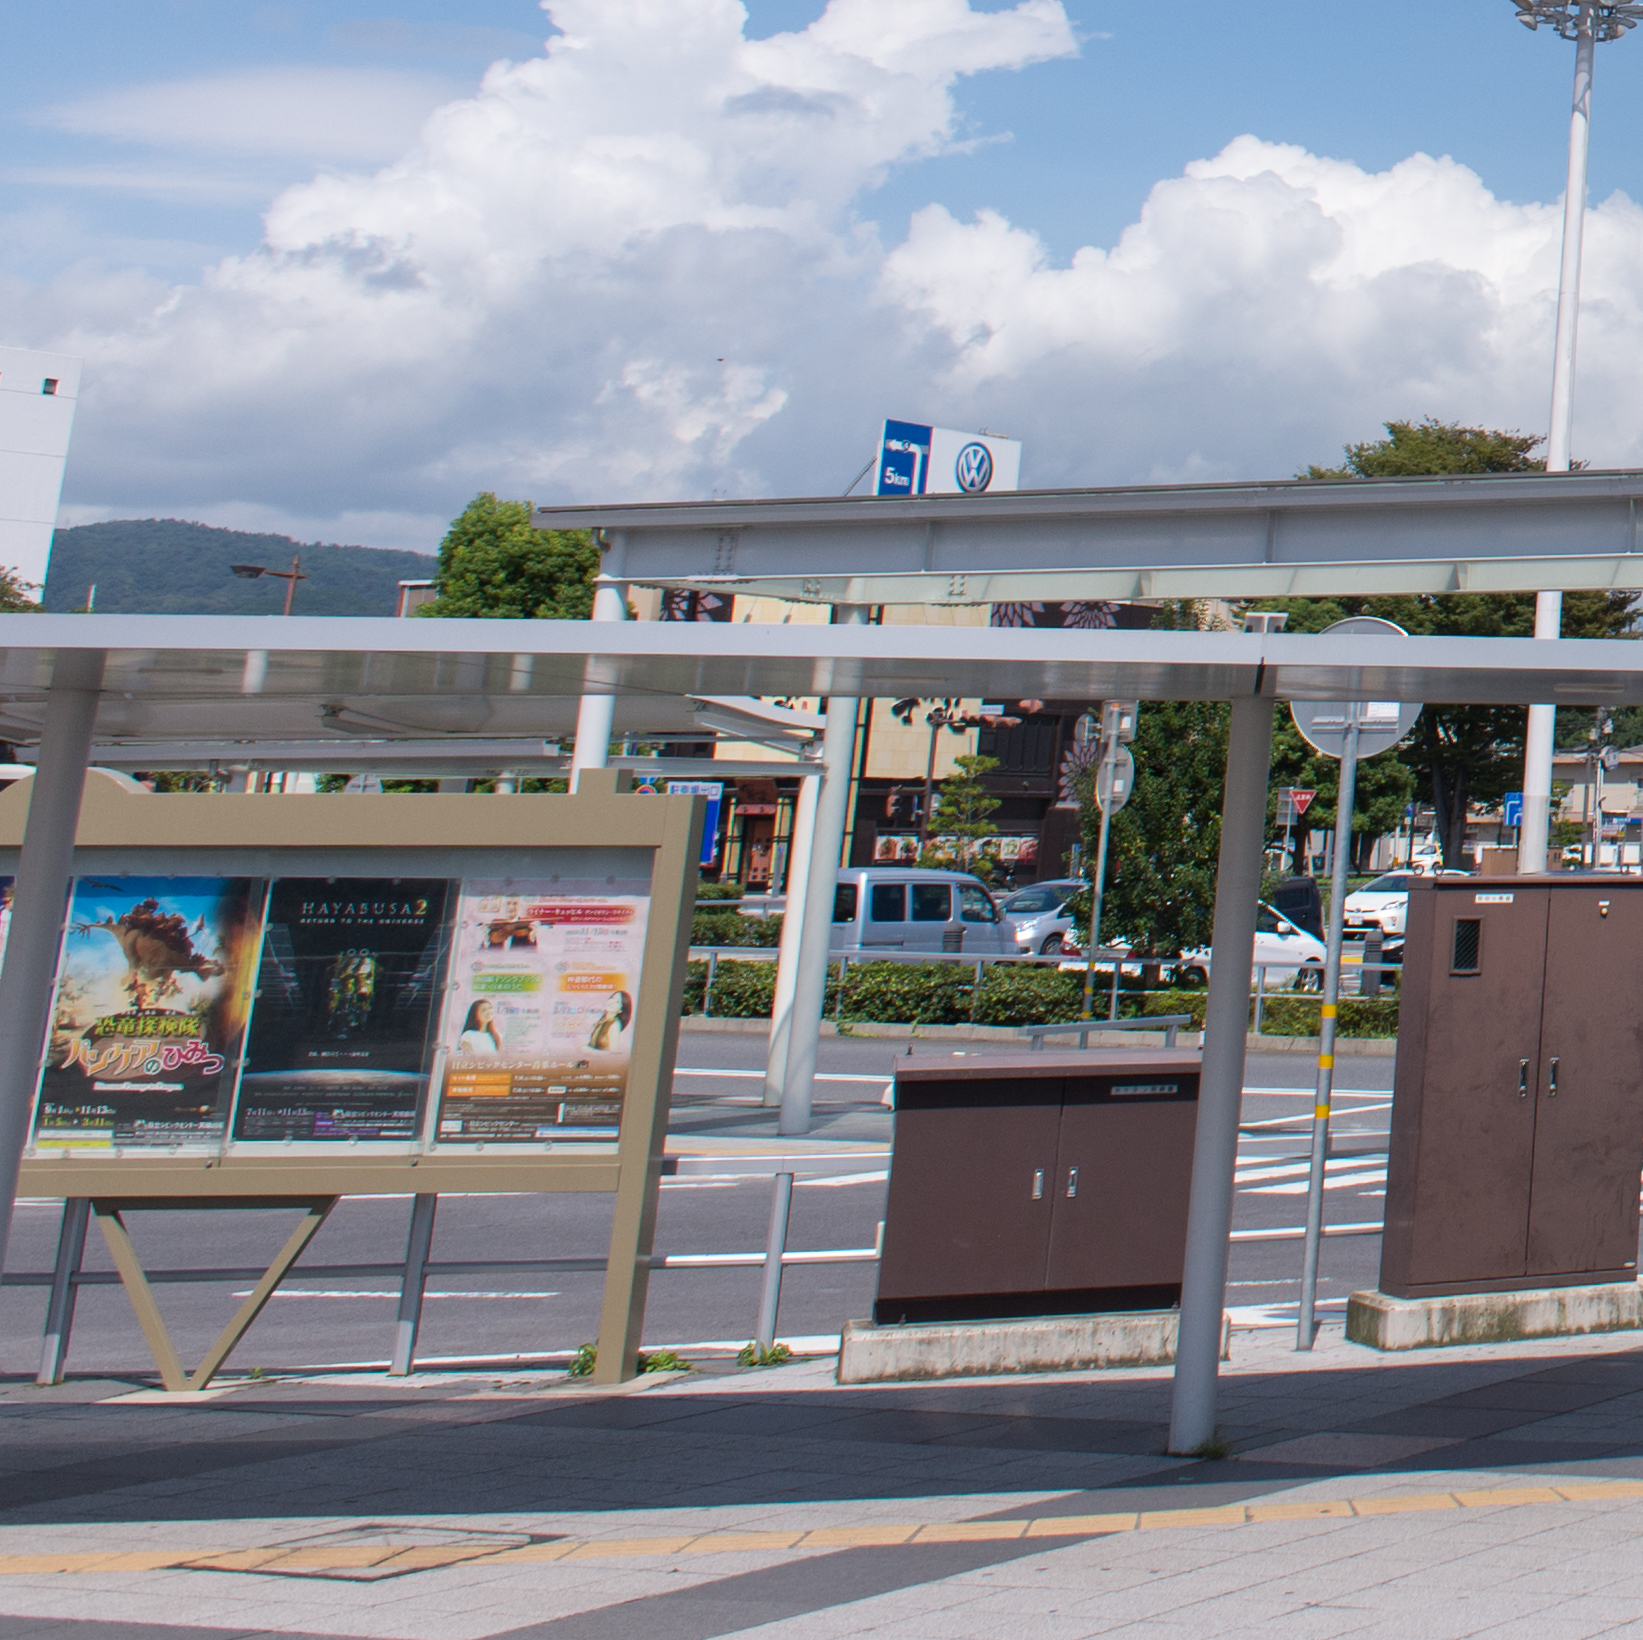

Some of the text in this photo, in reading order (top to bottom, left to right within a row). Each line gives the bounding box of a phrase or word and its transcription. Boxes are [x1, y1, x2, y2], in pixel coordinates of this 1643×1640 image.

[884, 466, 910, 487] 5km
[94, 1016, 201, 1037] 恐竜探検隊
[60, 1038, 225, 1077] パンゲアのひみつ
